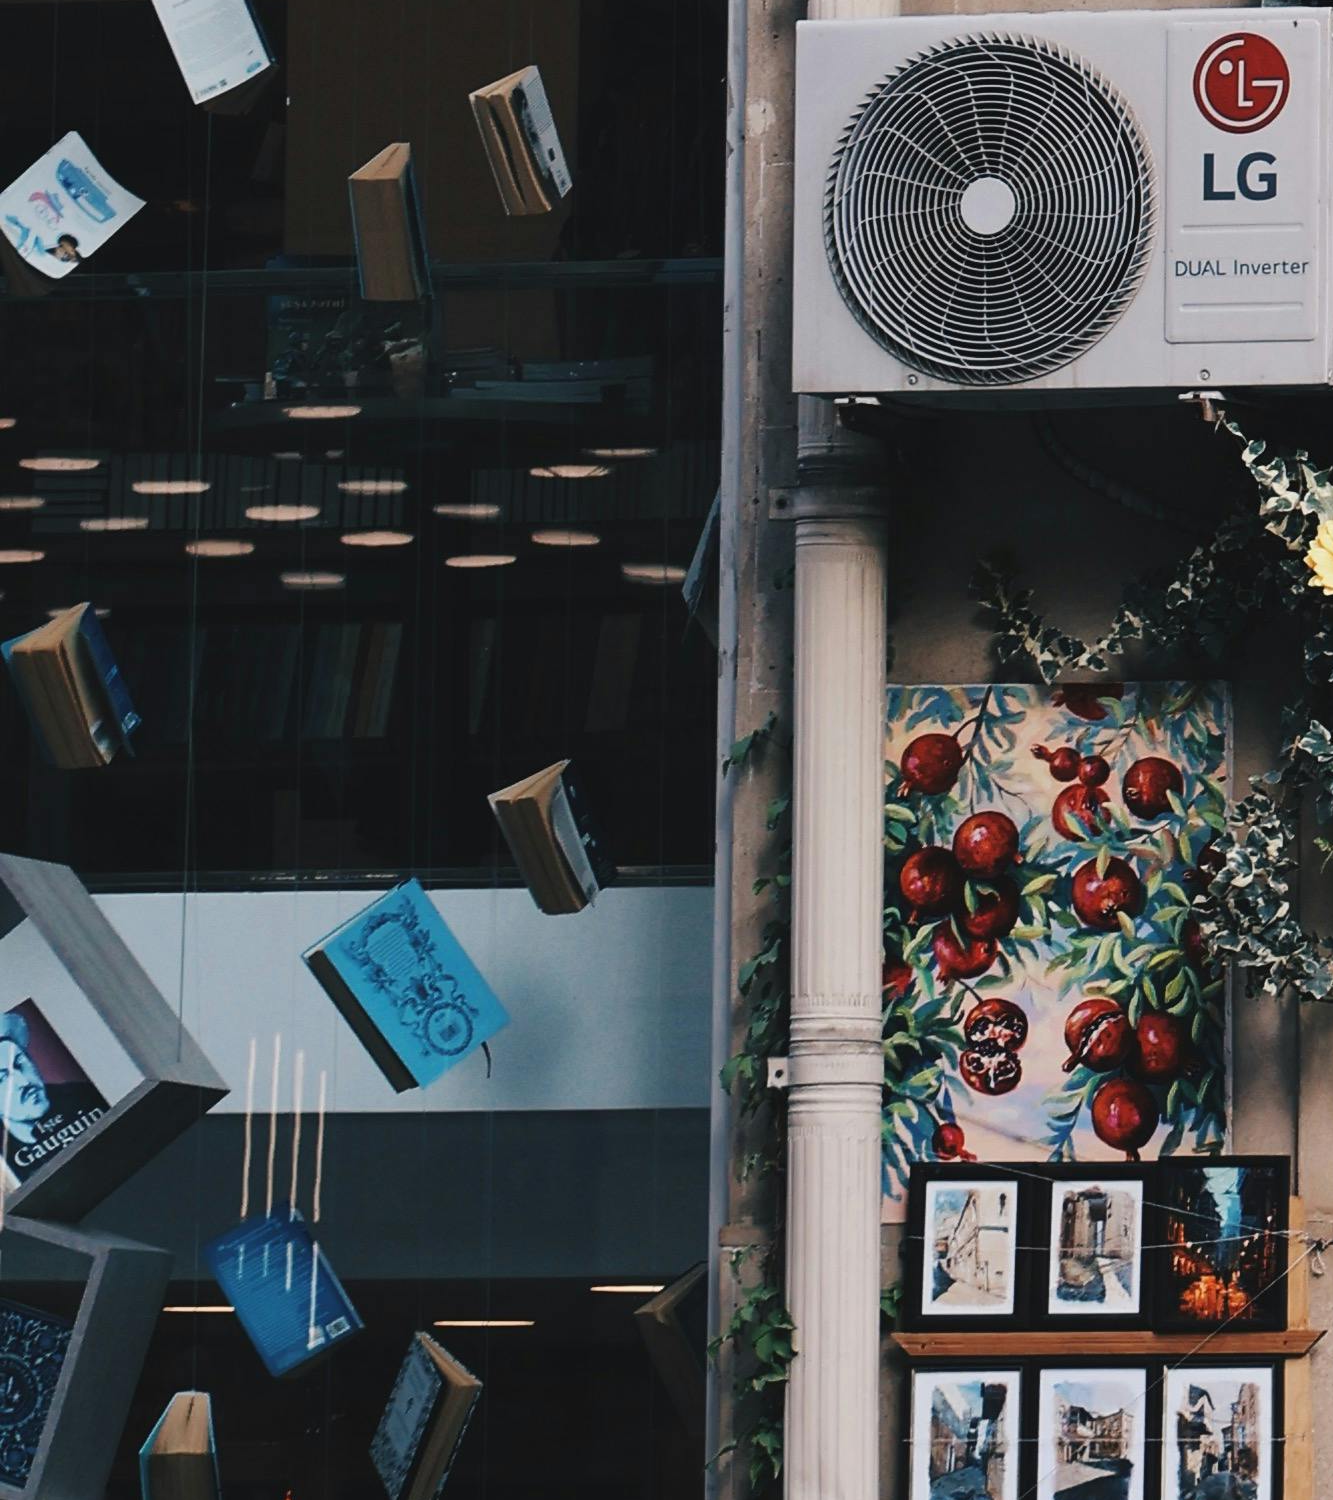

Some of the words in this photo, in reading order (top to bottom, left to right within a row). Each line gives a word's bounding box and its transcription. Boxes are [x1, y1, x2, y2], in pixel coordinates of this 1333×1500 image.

[1202, 152, 1278, 201] LG
[1174, 259, 1227, 278] DUAL
[1233, 259, 1310, 276] Inverter
